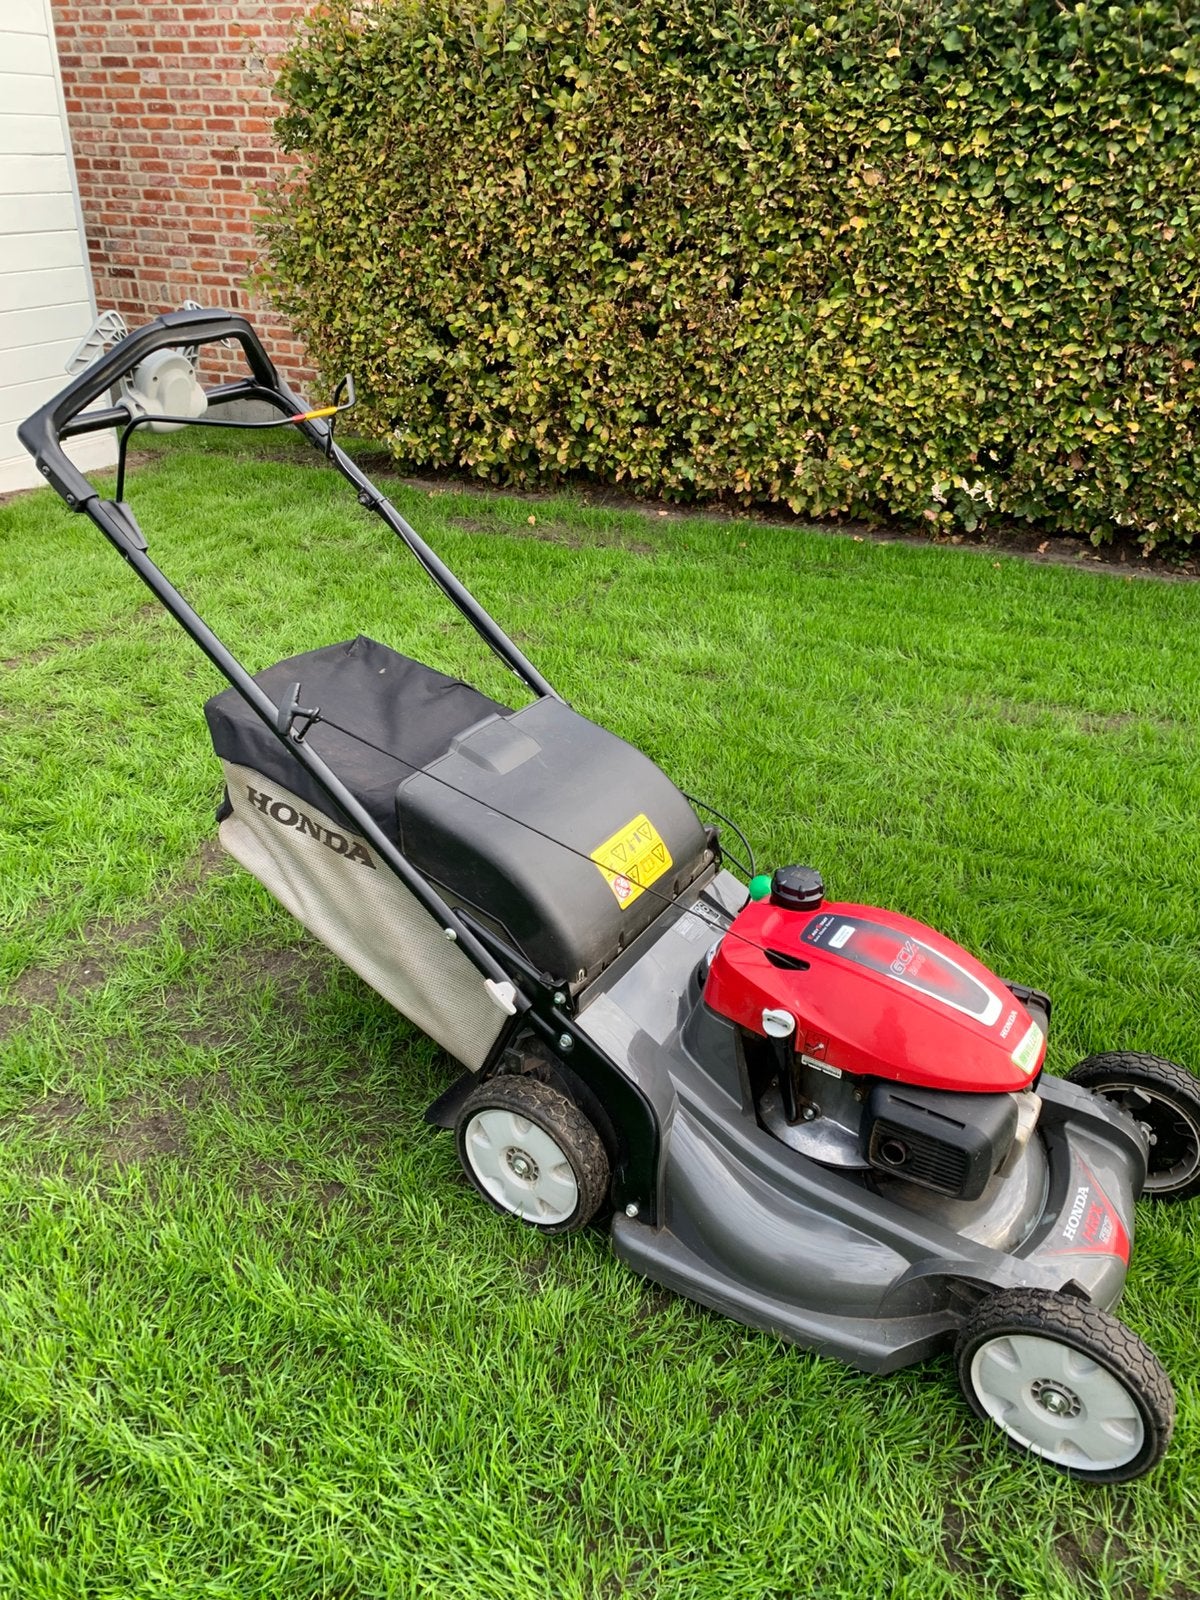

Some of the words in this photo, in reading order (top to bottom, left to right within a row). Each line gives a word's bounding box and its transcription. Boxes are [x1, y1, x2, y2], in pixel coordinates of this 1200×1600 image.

[247, 785, 376, 870] HONDA
[1000, 1010, 1018, 1039] HONDA
[1062, 1186, 1090, 1241] HONDA
